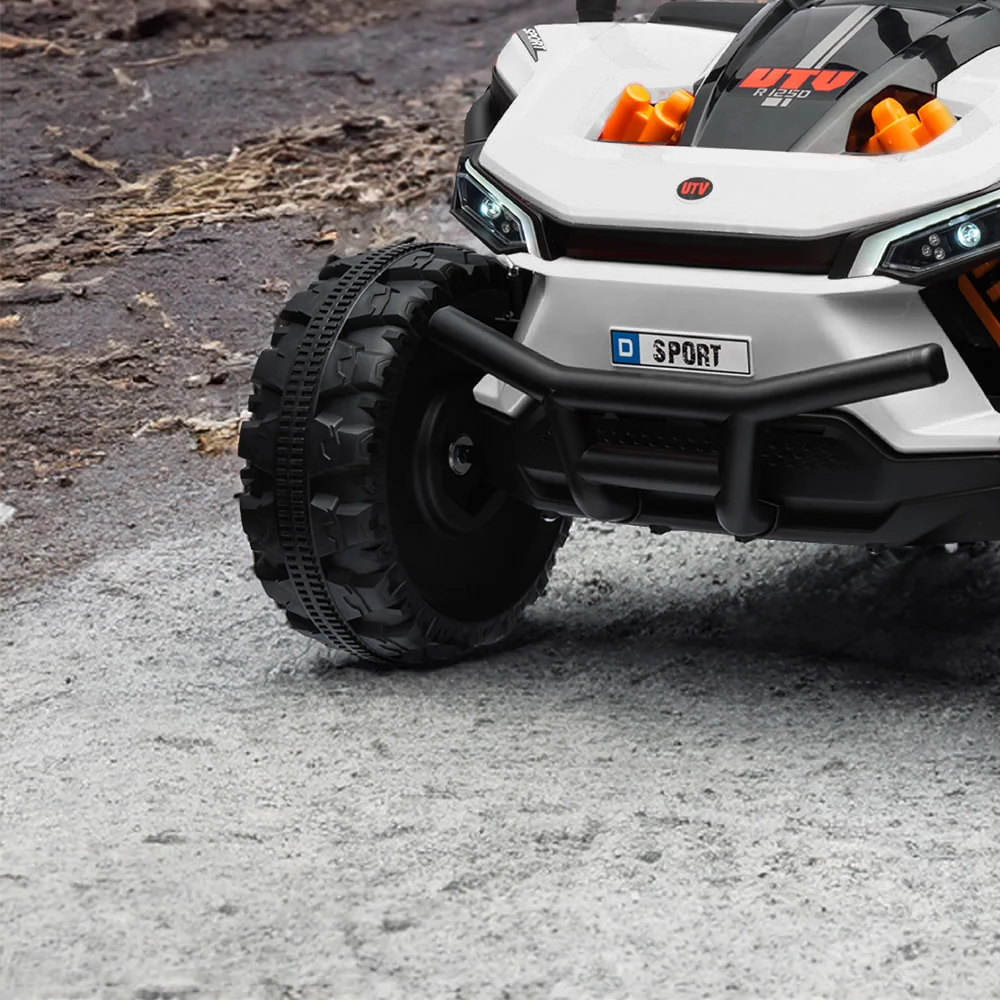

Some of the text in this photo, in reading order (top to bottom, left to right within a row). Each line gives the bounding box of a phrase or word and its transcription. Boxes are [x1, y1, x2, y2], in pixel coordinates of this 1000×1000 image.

[738, 67, 856, 92] UTV
[680, 181, 711, 196] UTV
[618, 338, 722, 368] D SPORT
